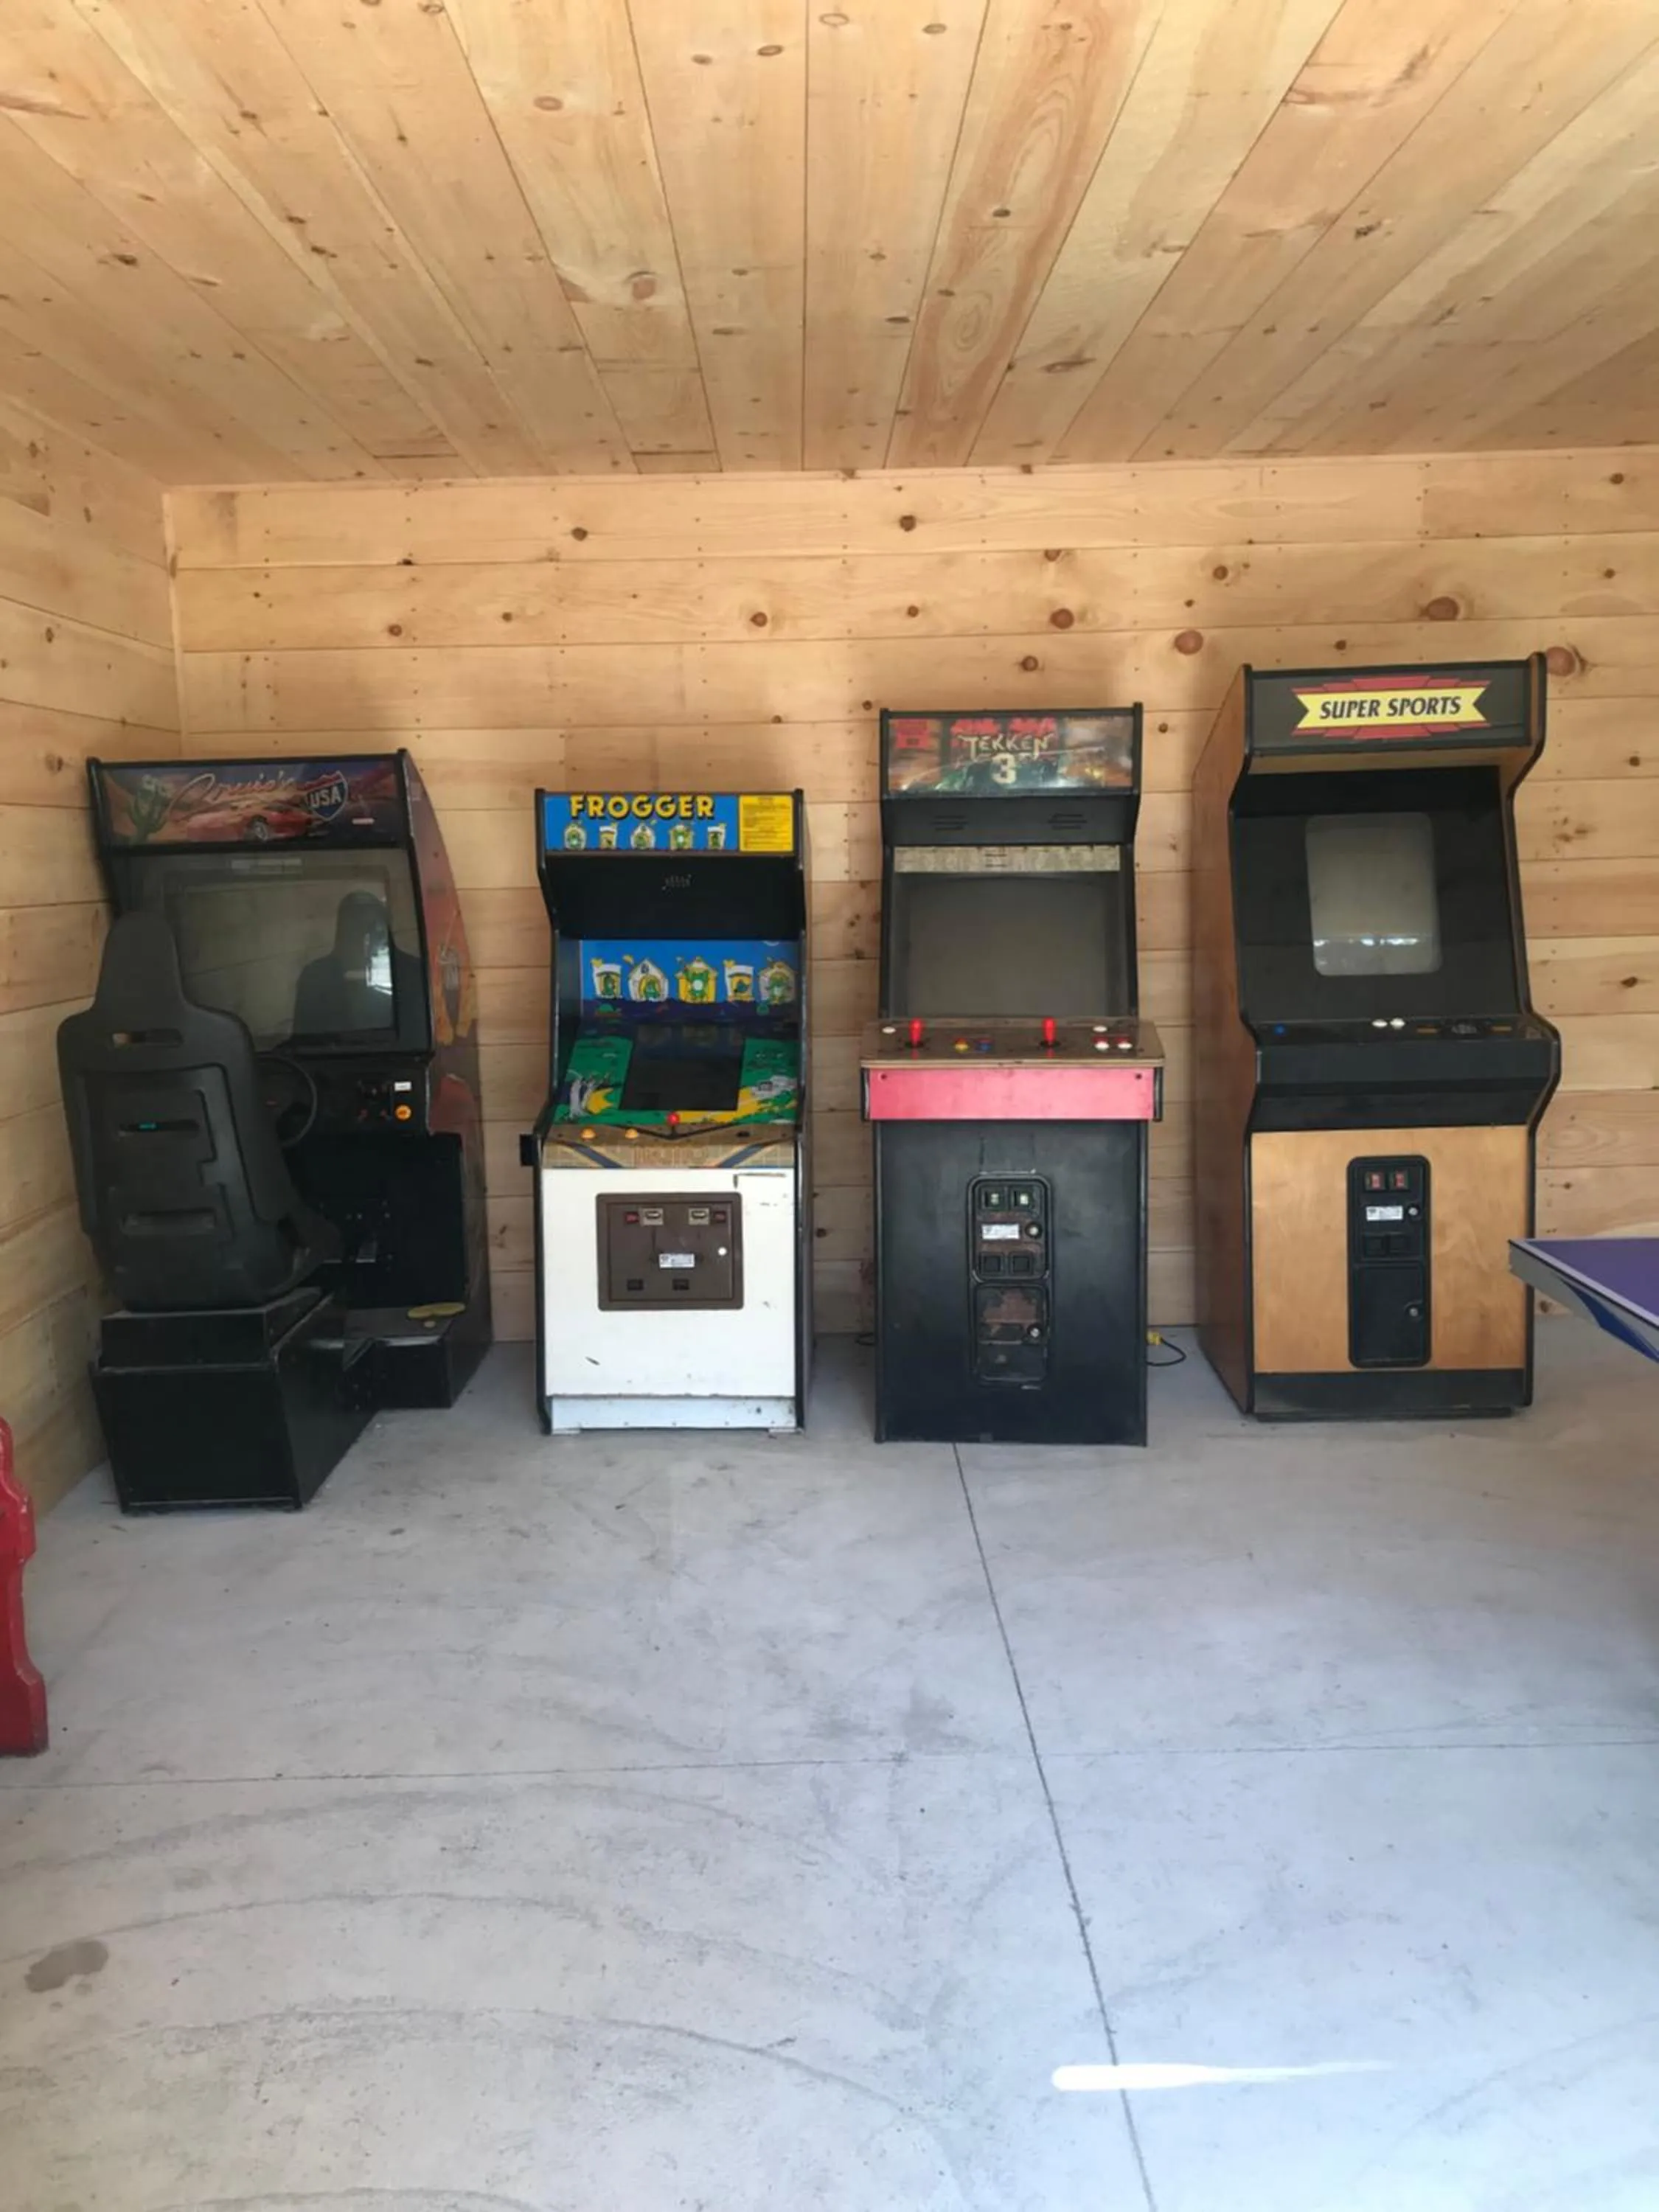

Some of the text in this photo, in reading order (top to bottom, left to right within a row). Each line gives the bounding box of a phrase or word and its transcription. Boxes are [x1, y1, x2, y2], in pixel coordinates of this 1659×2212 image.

[1319, 696, 1461, 720] SUPER SPORTS
[957, 732, 1054, 761] TEKKEN
[991, 752, 1017, 785] 3
[309, 785, 341, 808] USA
[569, 795, 714, 819] FROGGER
